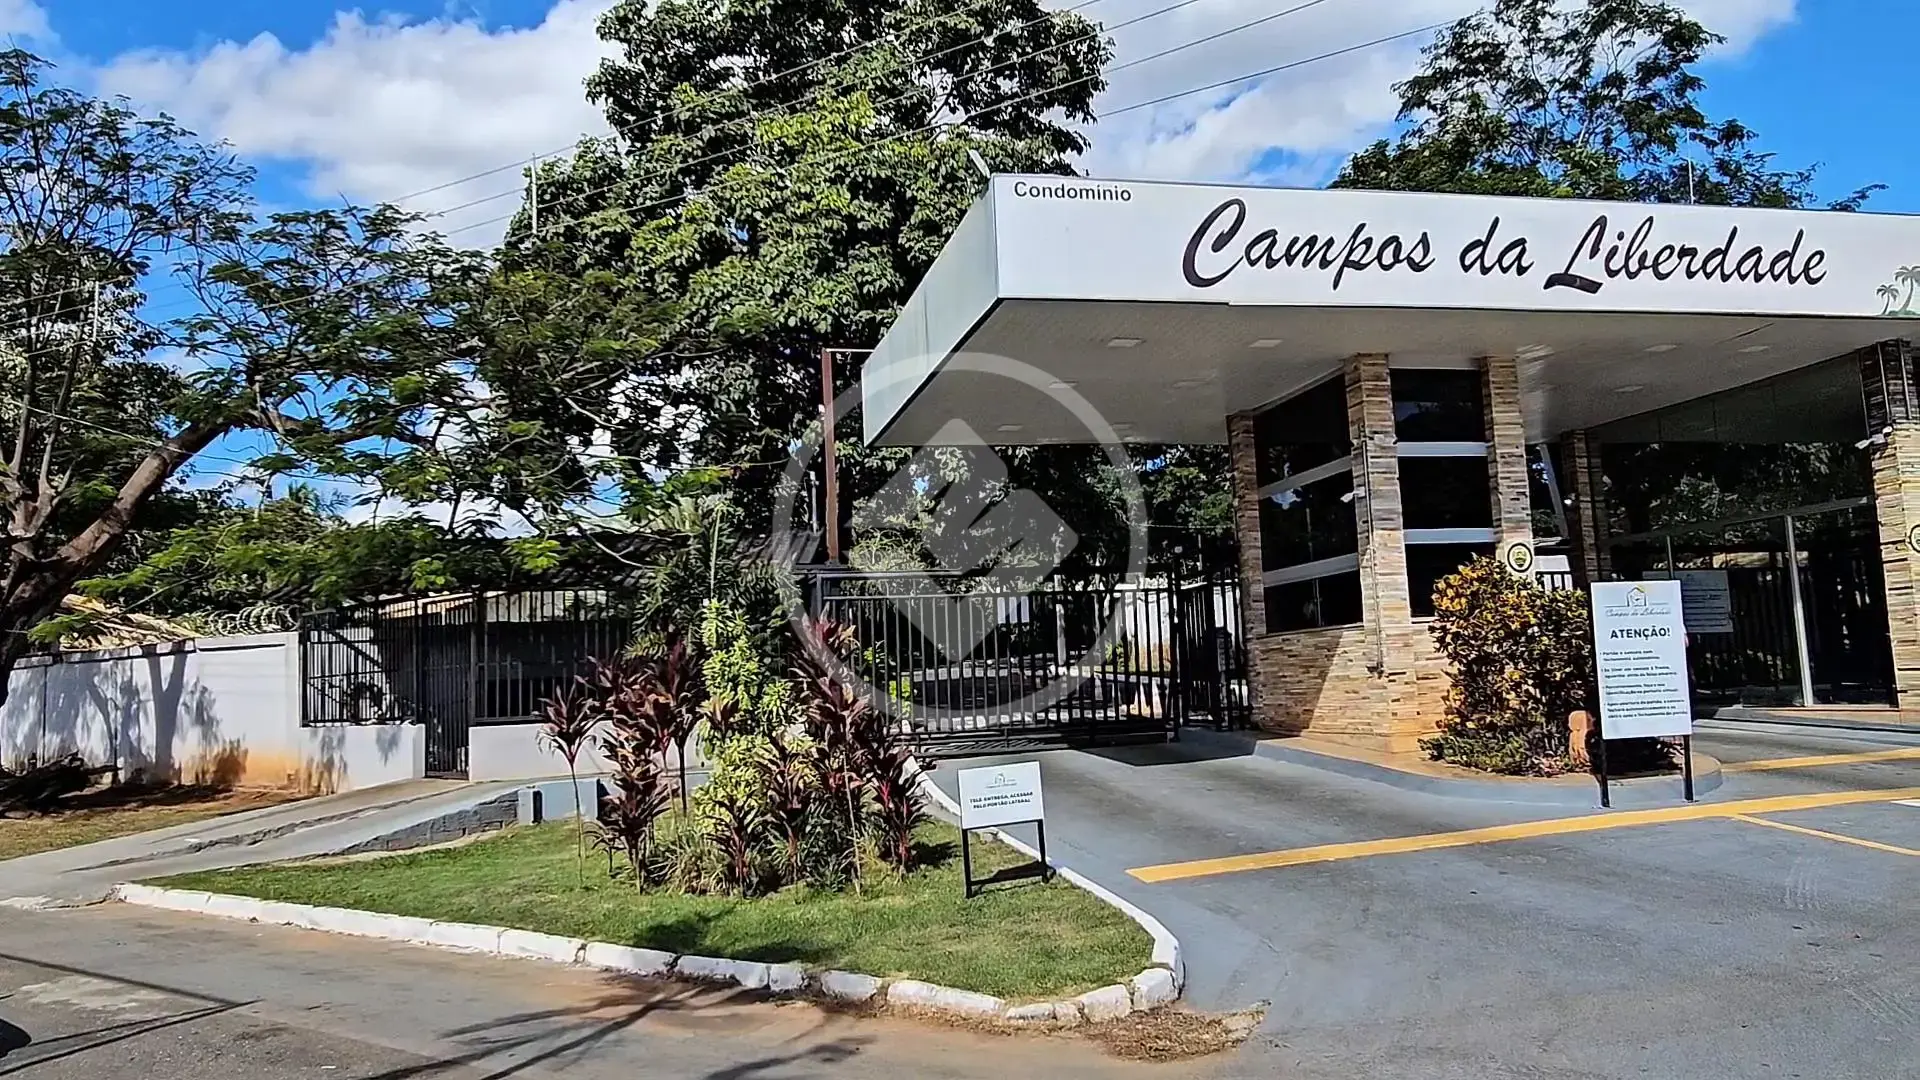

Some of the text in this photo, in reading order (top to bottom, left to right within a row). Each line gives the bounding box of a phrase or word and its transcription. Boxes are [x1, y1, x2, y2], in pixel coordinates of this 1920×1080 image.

[1014, 181, 1133, 202] Condomínio
[1183, 198, 1827, 294] Campos da Liberdade
[1610, 625, 1671, 641] ATENÇÃO!
